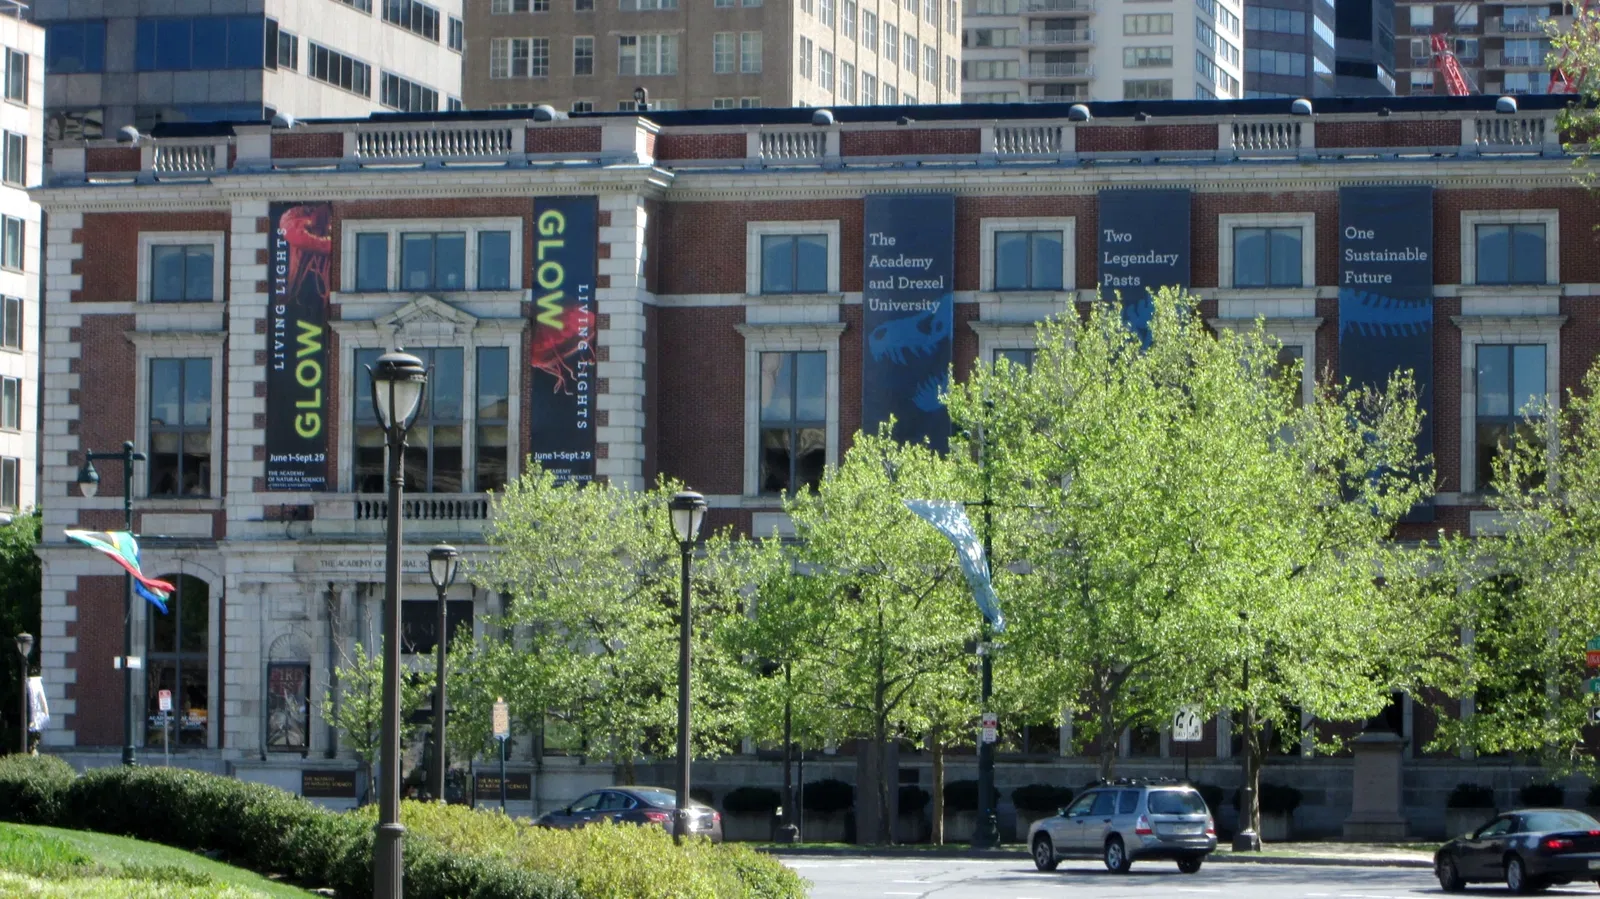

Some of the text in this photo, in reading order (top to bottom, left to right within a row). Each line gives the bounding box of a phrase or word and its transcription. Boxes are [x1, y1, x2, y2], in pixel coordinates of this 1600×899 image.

[869, 232, 896, 246] The
[1103, 229, 1132, 242] Two
[1345, 226, 1374, 239] One
[1103, 250, 1179, 267] Legendary
[1345, 247, 1427, 261] Sustainable
[869, 254, 933, 270] Academy
[537, 210, 565, 331] GLOW
[1345, 271, 1392, 284] Future
[869, 275, 944, 289] and Drexel
[1103, 273, 1141, 286] Pasts
[275, 227, 287, 370] LIVING LIGHTS
[868, 298, 941, 313] University
[577, 284, 588, 429] LIVING LIGHTS
[295, 319, 322, 438] GLOW
[270, 454, 288, 462] June
[314, 454, 325, 462] 29
[580, 452, 591, 460] 29
